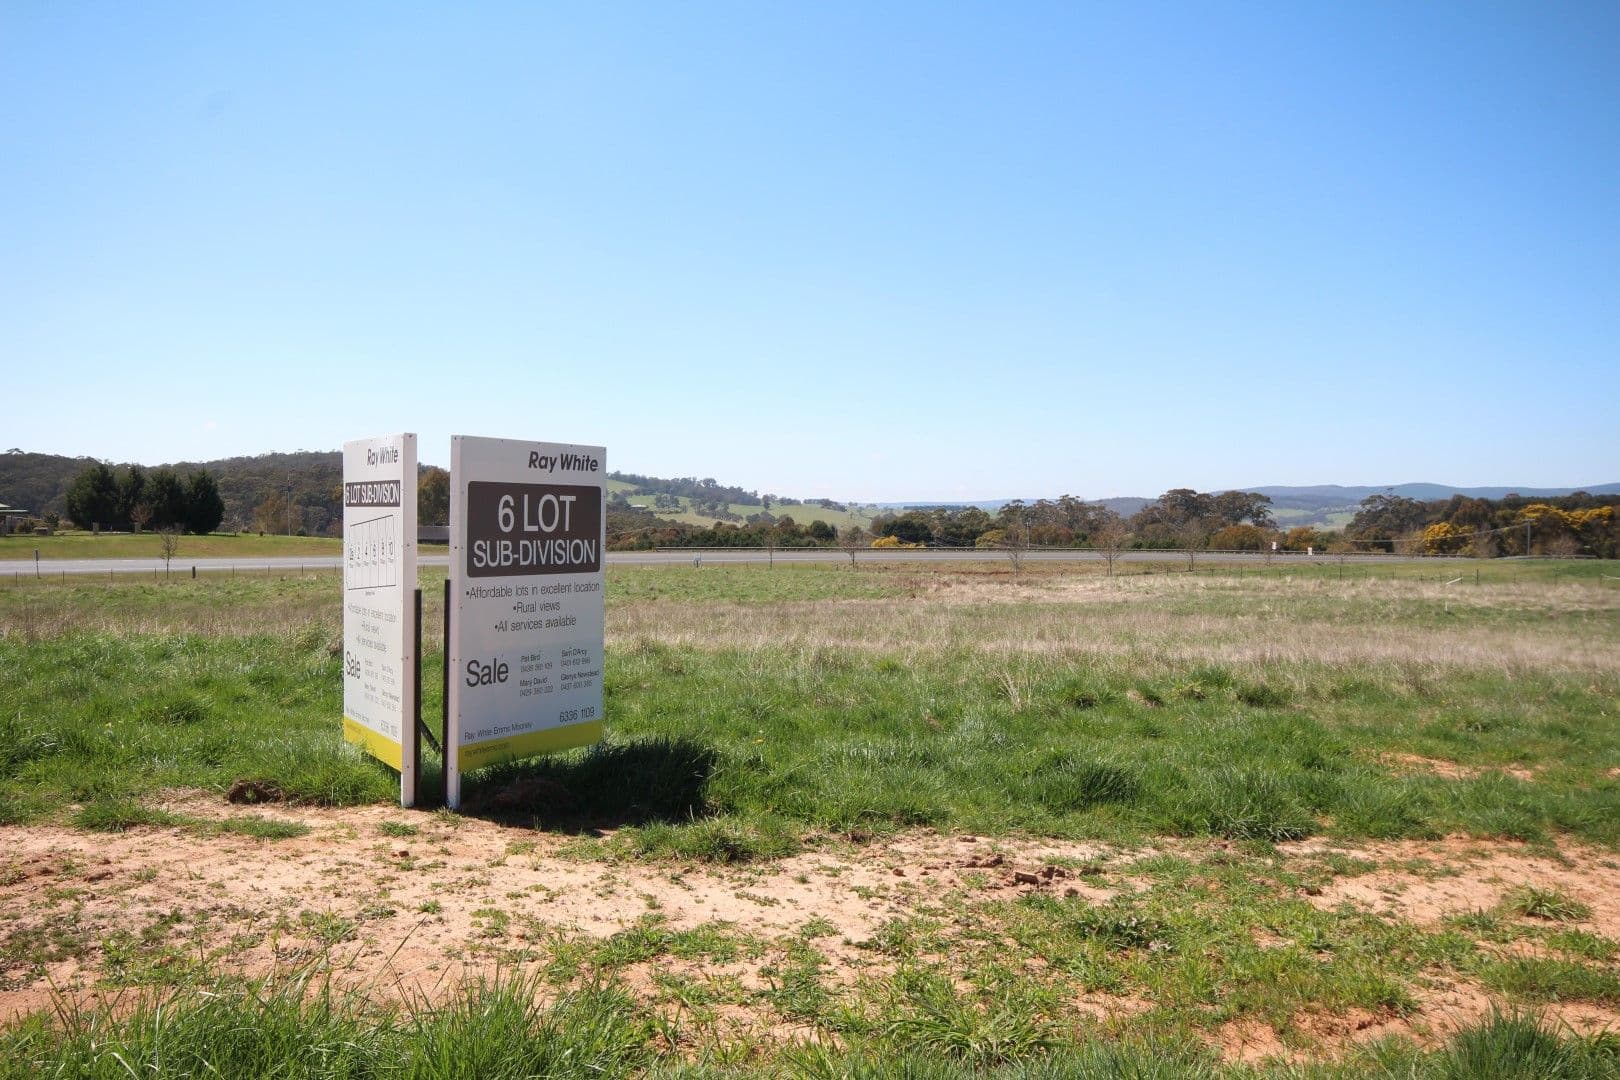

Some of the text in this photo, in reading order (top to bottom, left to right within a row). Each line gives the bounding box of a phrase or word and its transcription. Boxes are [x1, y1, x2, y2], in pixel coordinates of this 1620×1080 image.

[367, 445, 398, 468] Ray White
[528, 451, 599, 473] Ray White
[350, 485, 361, 504] LOT
[498, 493, 577, 533] 6 LOT
[473, 539, 596, 568] SUB-DIVISION
[469, 582, 600, 600] Affordable lots in excellent location
[516, 601, 561, 614] Rural views
[497, 616, 577, 633] All services available
[346, 650, 361, 680] Sale
[466, 658, 509, 688] Sale
